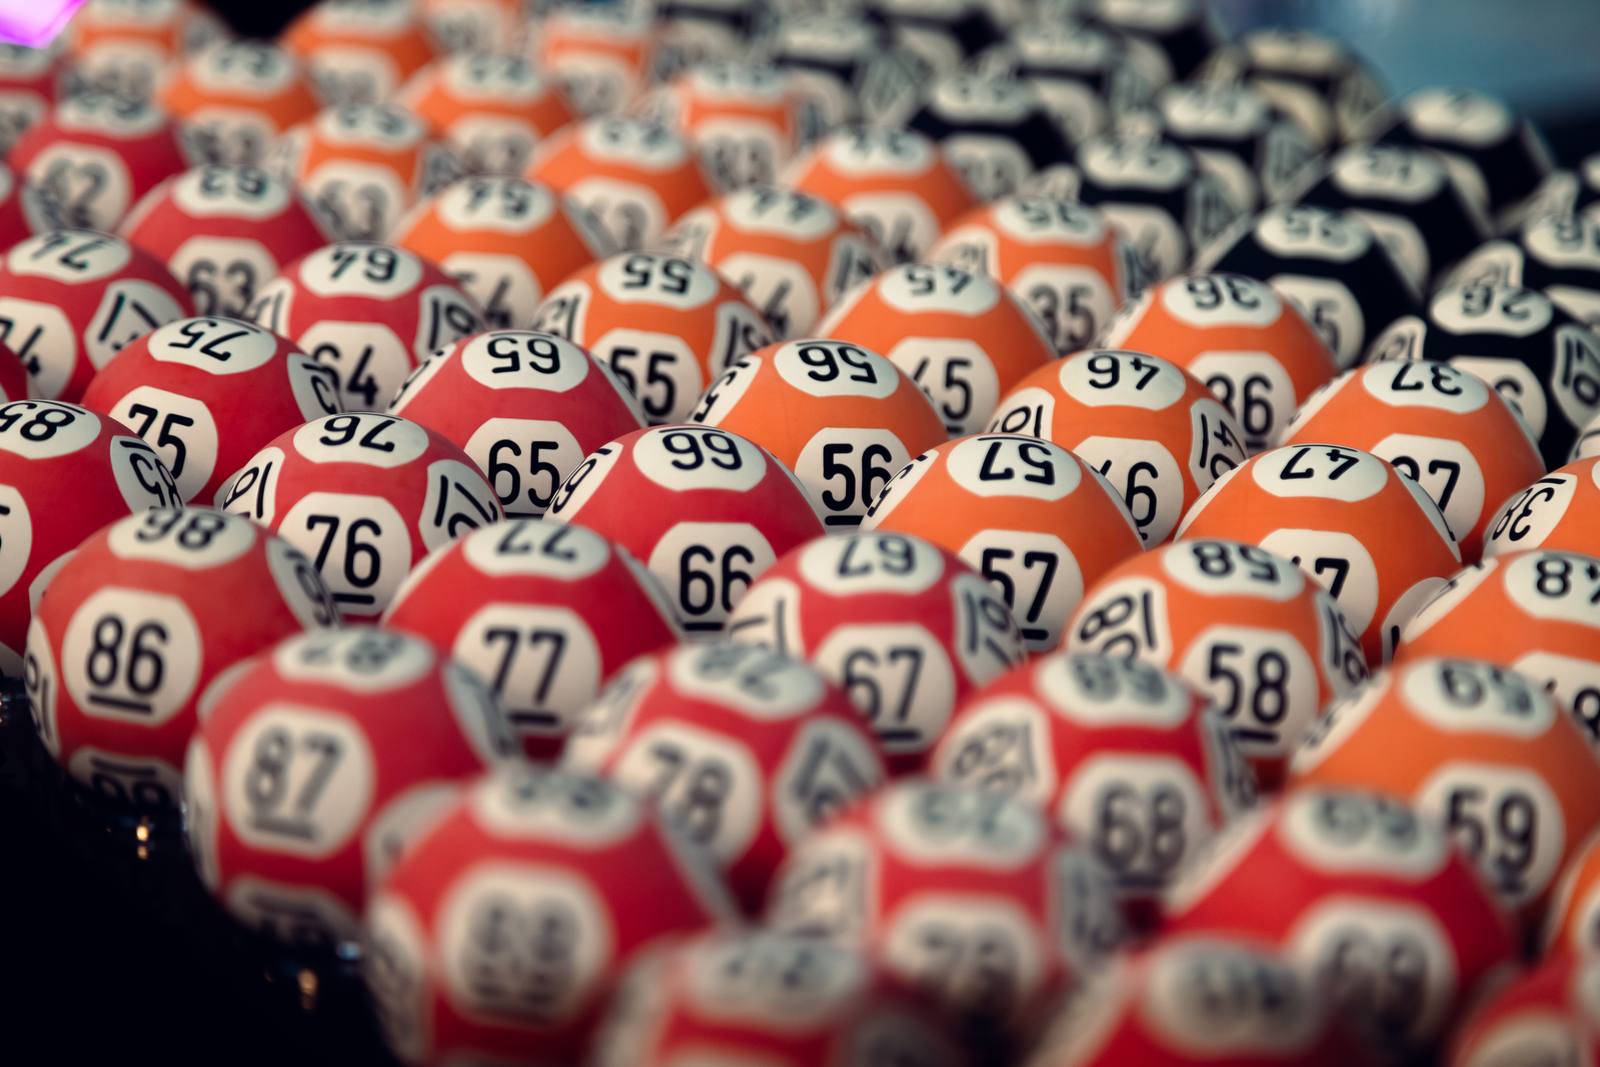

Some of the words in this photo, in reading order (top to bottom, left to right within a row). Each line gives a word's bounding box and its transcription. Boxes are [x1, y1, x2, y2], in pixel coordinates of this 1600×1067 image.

[332, 248, 399, 281] 64
[622, 255, 694, 295] 55
[905, 265, 973, 297] 45
[1189, 275, 1260, 311] 36
[169, 321, 251, 362] 75
[487, 337, 561, 374] 65
[610, 346, 677, 417] 55
[799, 345, 877, 384] 56
[1087, 354, 1161, 390] 46
[1391, 364, 1462, 396] 37
[129, 403, 194, 479] 75
[320, 416, 398, 453] 76
[662, 432, 742, 471] 66
[489, 439, 560, 508] 65
[822, 443, 892, 511] 56
[980, 442, 1055, 485] 57
[1280, 448, 1359, 480] 47
[135, 508, 225, 550] 86
[306, 515, 382, 588] 76
[838, 537, 916, 577] 67
[1193, 543, 1279, 582] 58
[680, 545, 754, 615] 66
[982, 548, 1058, 623] 57
[86, 614, 169, 695] 86
[485, 628, 567, 705] 77
[845, 647, 925, 724] 67
[1208, 645, 1289, 724] 58
[246, 727, 344, 815] 87
[1096, 780, 1186, 868] 68
[1447, 789, 1539, 872] 59
